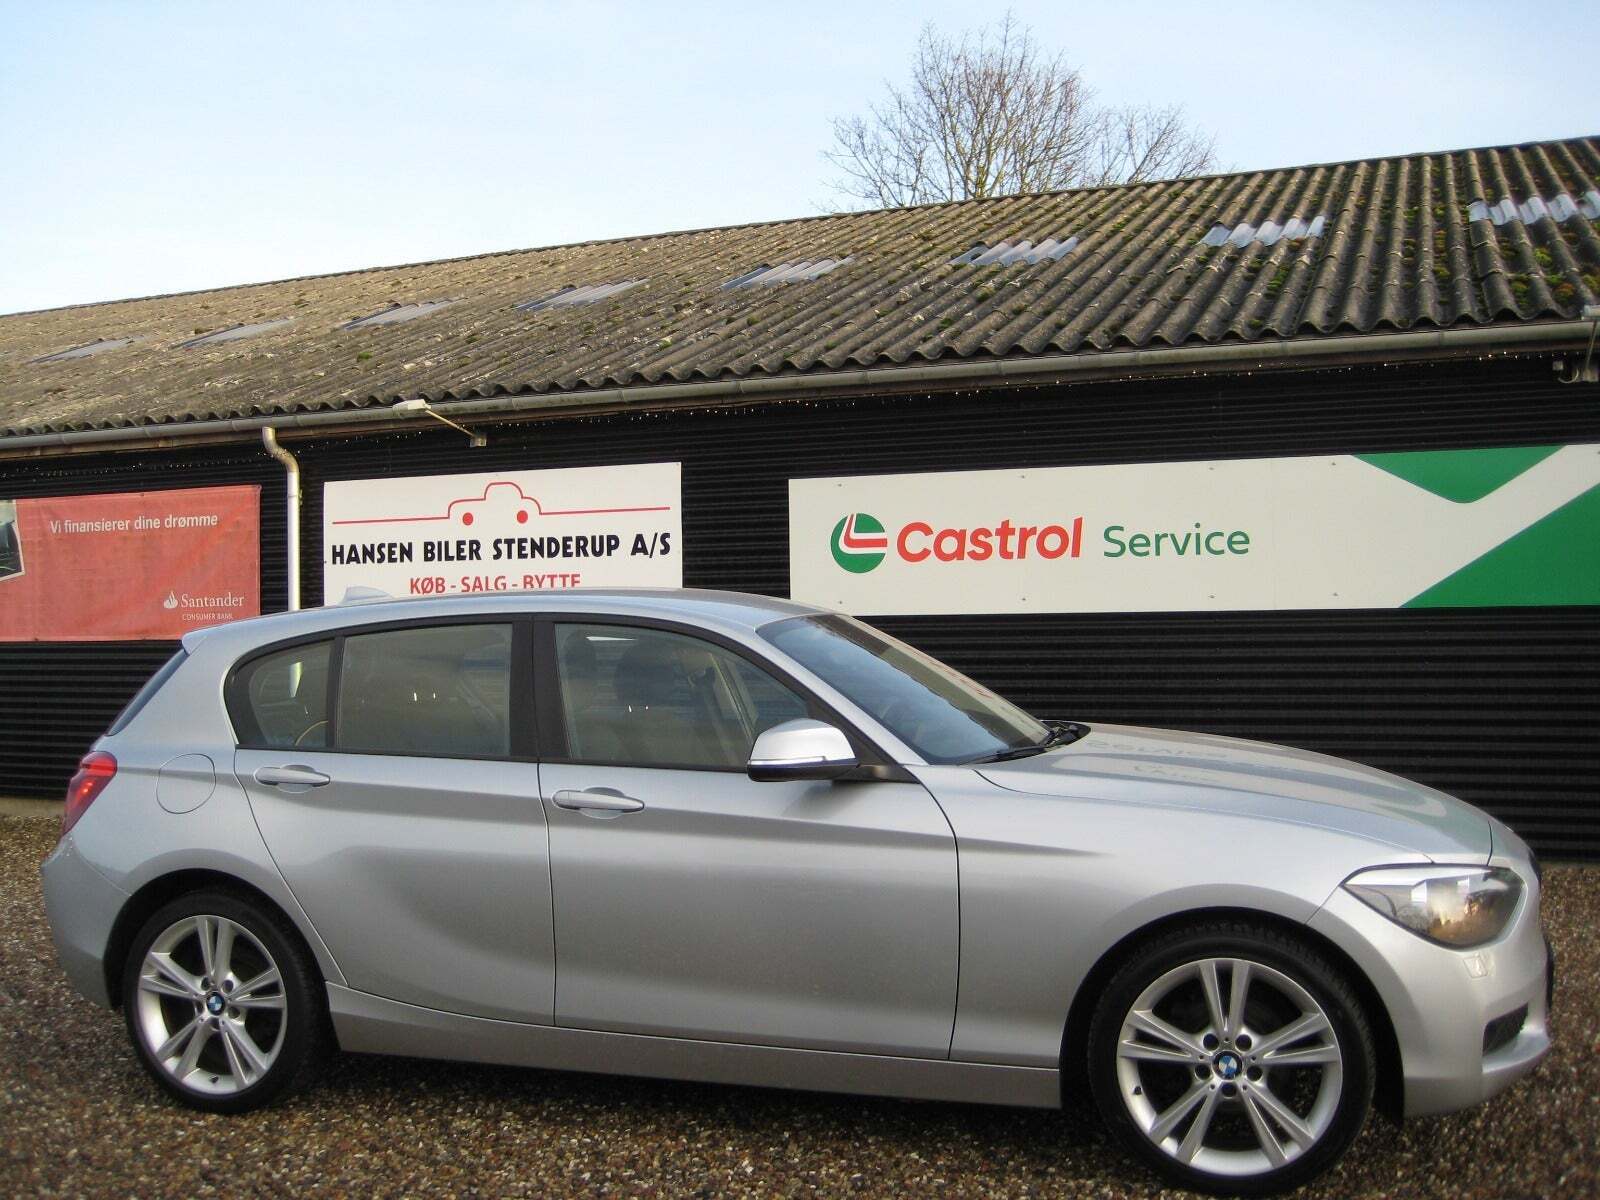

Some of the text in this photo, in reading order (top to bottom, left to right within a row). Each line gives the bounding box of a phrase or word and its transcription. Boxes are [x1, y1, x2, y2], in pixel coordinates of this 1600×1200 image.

[50, 513, 218, 534] Vi finansierer dine drømme
[331, 532, 671, 565] HANSEN BILER STENDERUP A/S
[896, 516, 1250, 562] Castrol Service
[409, 577, 446, 595] KØB
[460, 575, 507, 592] SALG
[180, 591, 245, 608] Santander
